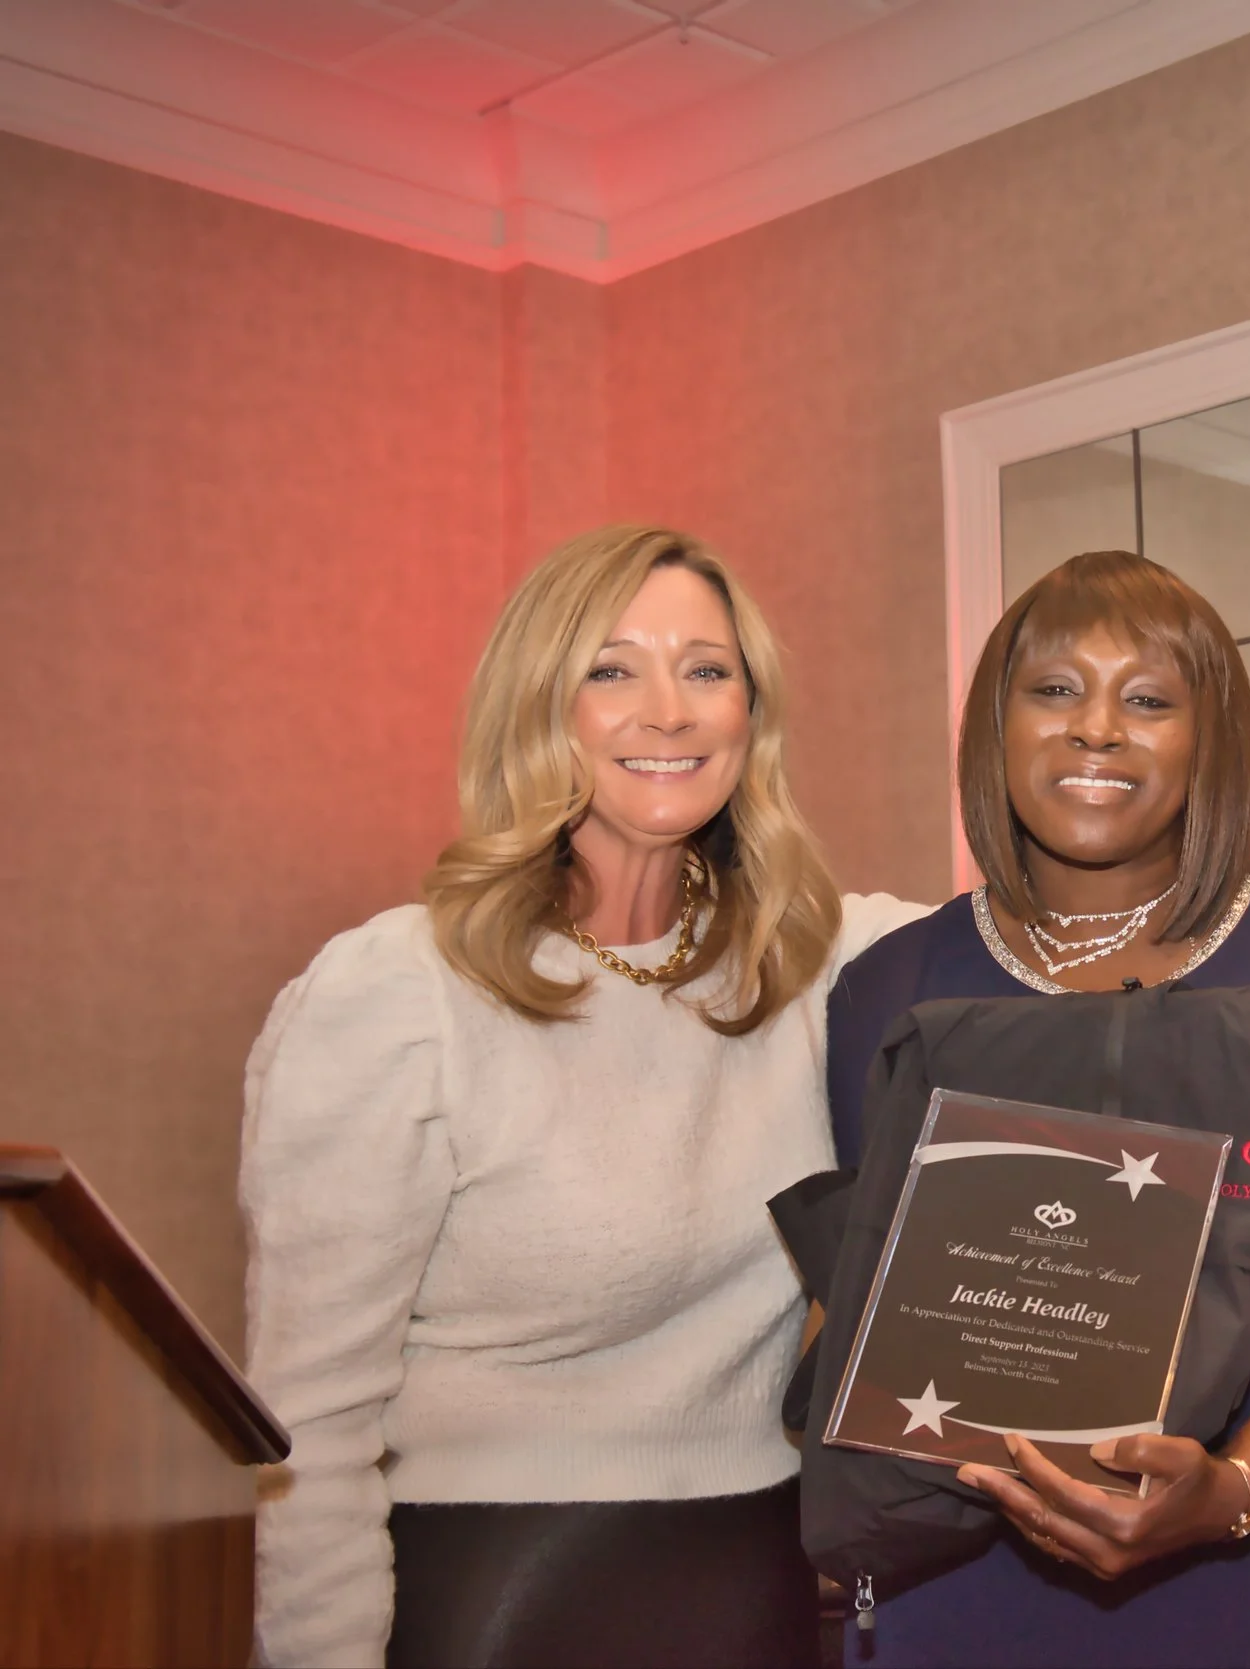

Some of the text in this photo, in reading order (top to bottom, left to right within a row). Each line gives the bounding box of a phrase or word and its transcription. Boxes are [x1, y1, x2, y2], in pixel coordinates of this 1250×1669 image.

[1011, 1226, 1089, 1245] HOLY ANGELS
[946, 1241, 1141, 1286] Achievement of Excellence Award
[1016, 1275, 1048, 1288] Presented
[949, 1284, 1110, 1330] Jackie Headley
[900, 1303, 1150, 1355] In Appreciation for Dedicated and Outstanding Service
[960, 1332, 1078, 1361] Direct Support Professional
[964, 1360, 1060, 1385] Belmont, North Carolina
